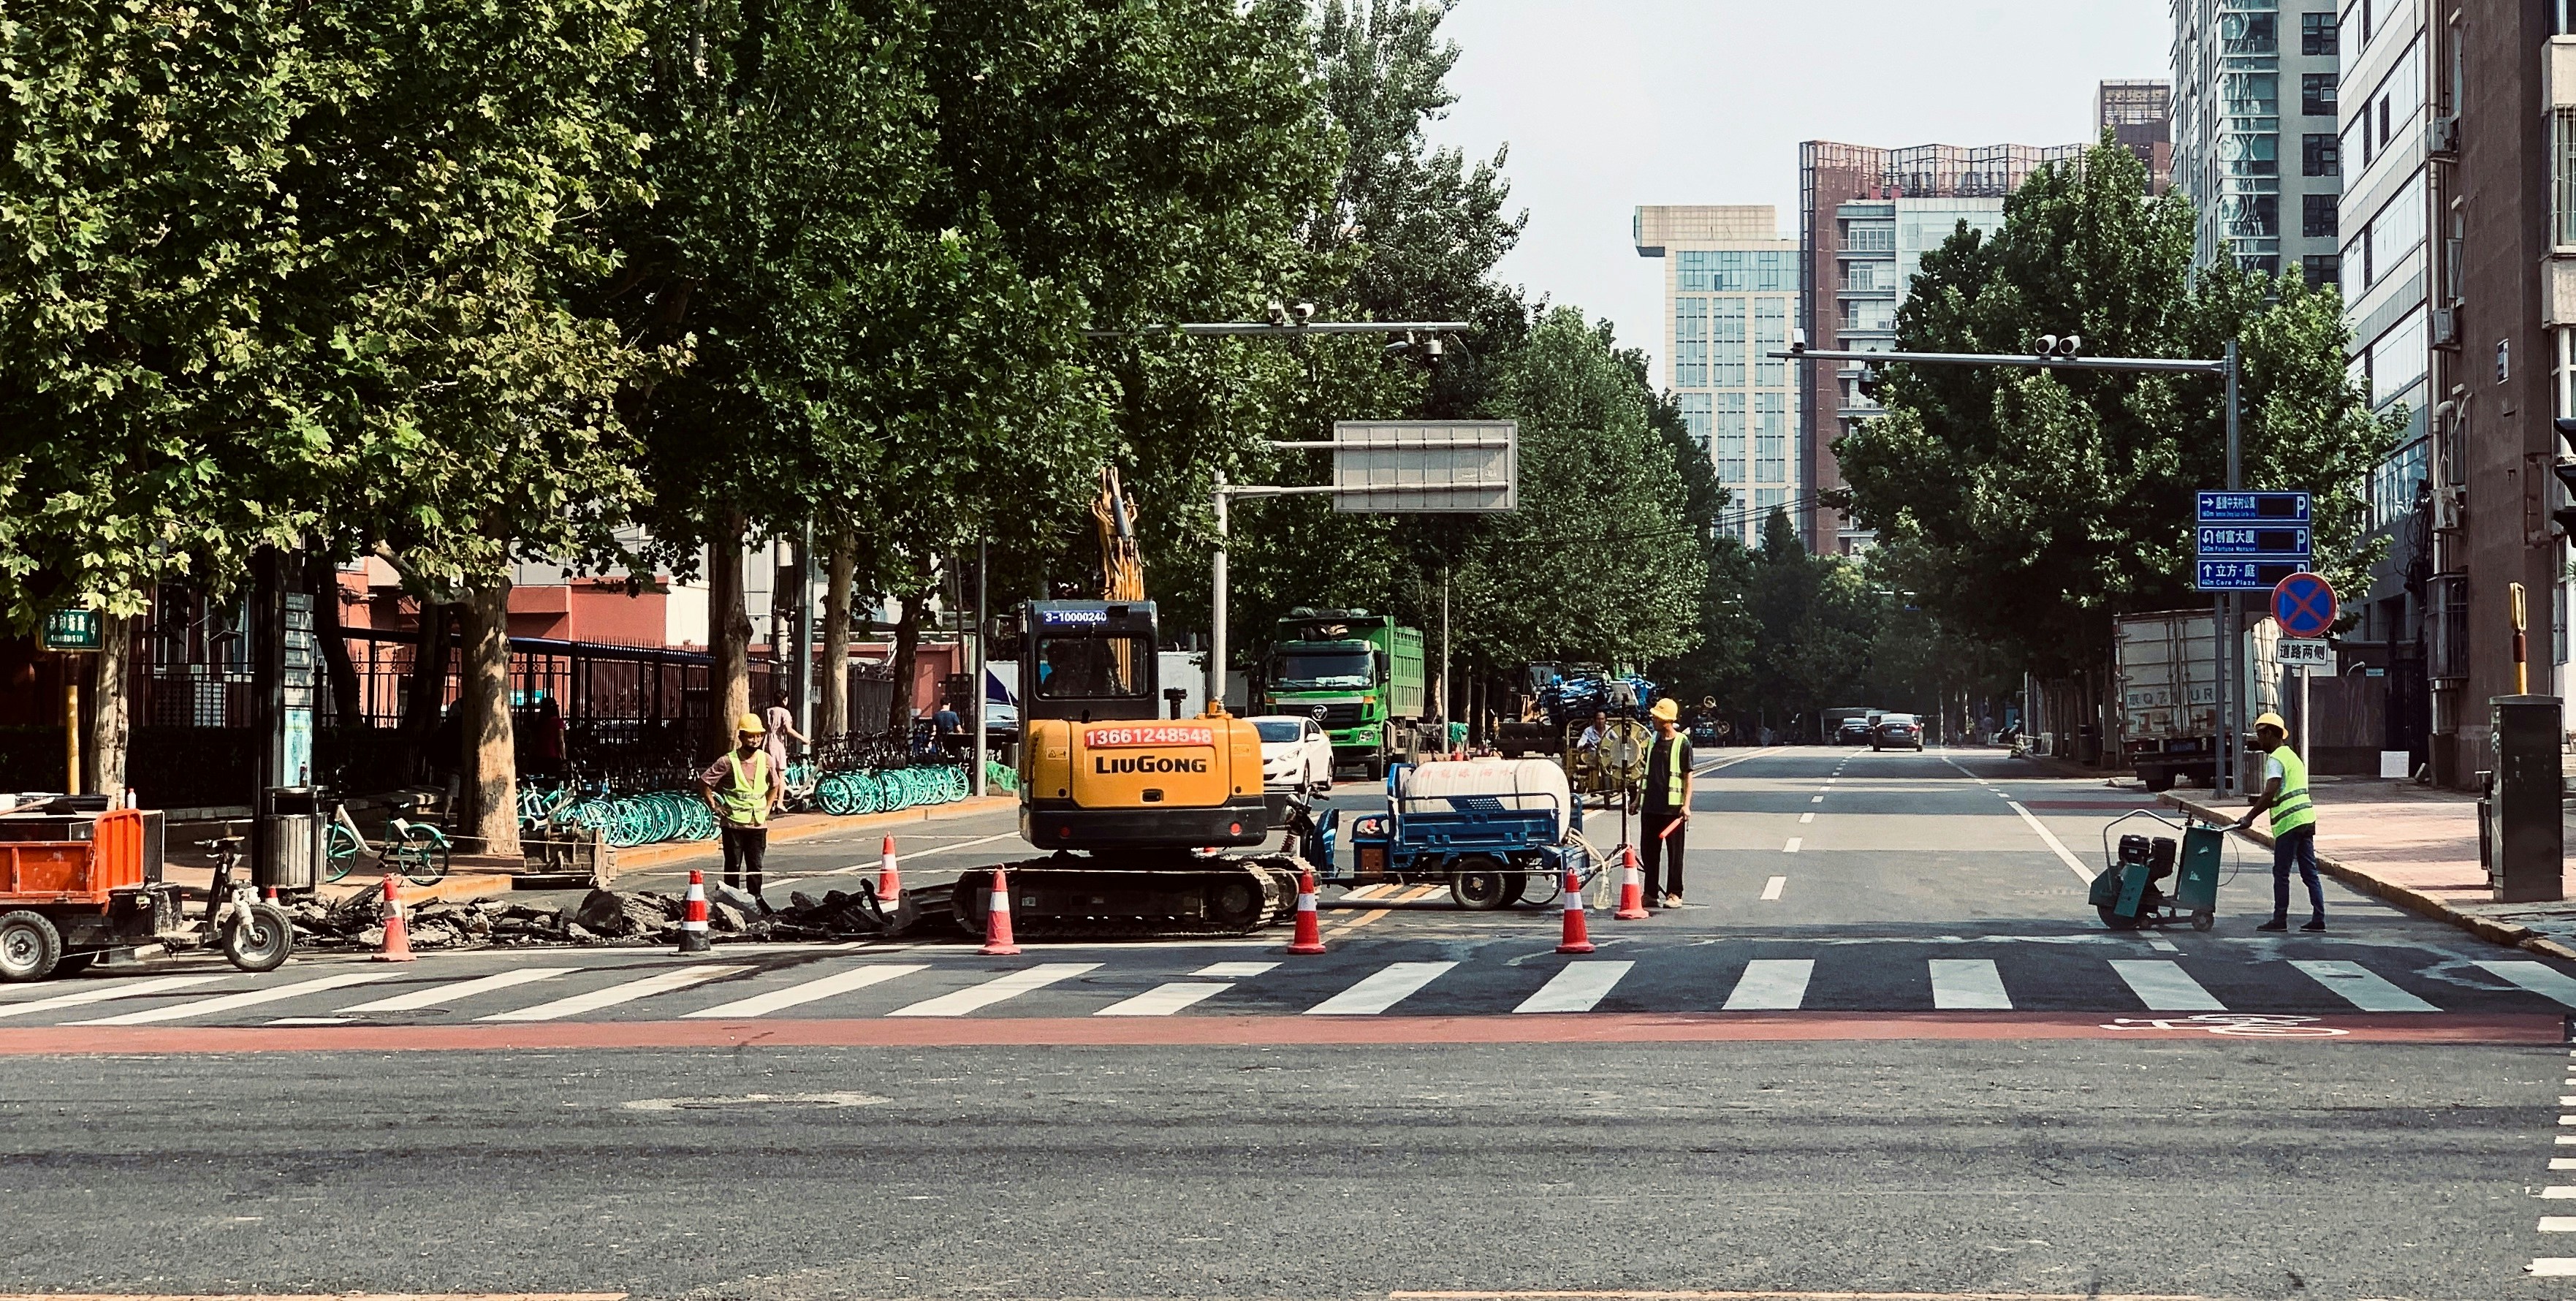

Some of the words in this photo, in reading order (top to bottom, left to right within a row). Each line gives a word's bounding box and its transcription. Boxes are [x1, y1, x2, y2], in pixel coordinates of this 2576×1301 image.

[2216, 530, 2255, 544] 创富大厦
[1045, 612, 1107, 622] 3-10000240
[2279, 643, 2325, 661] 道路两侧
[1086, 728, 1212, 746] 13661248548
[1095, 755, 1207, 774] LIUGONG
